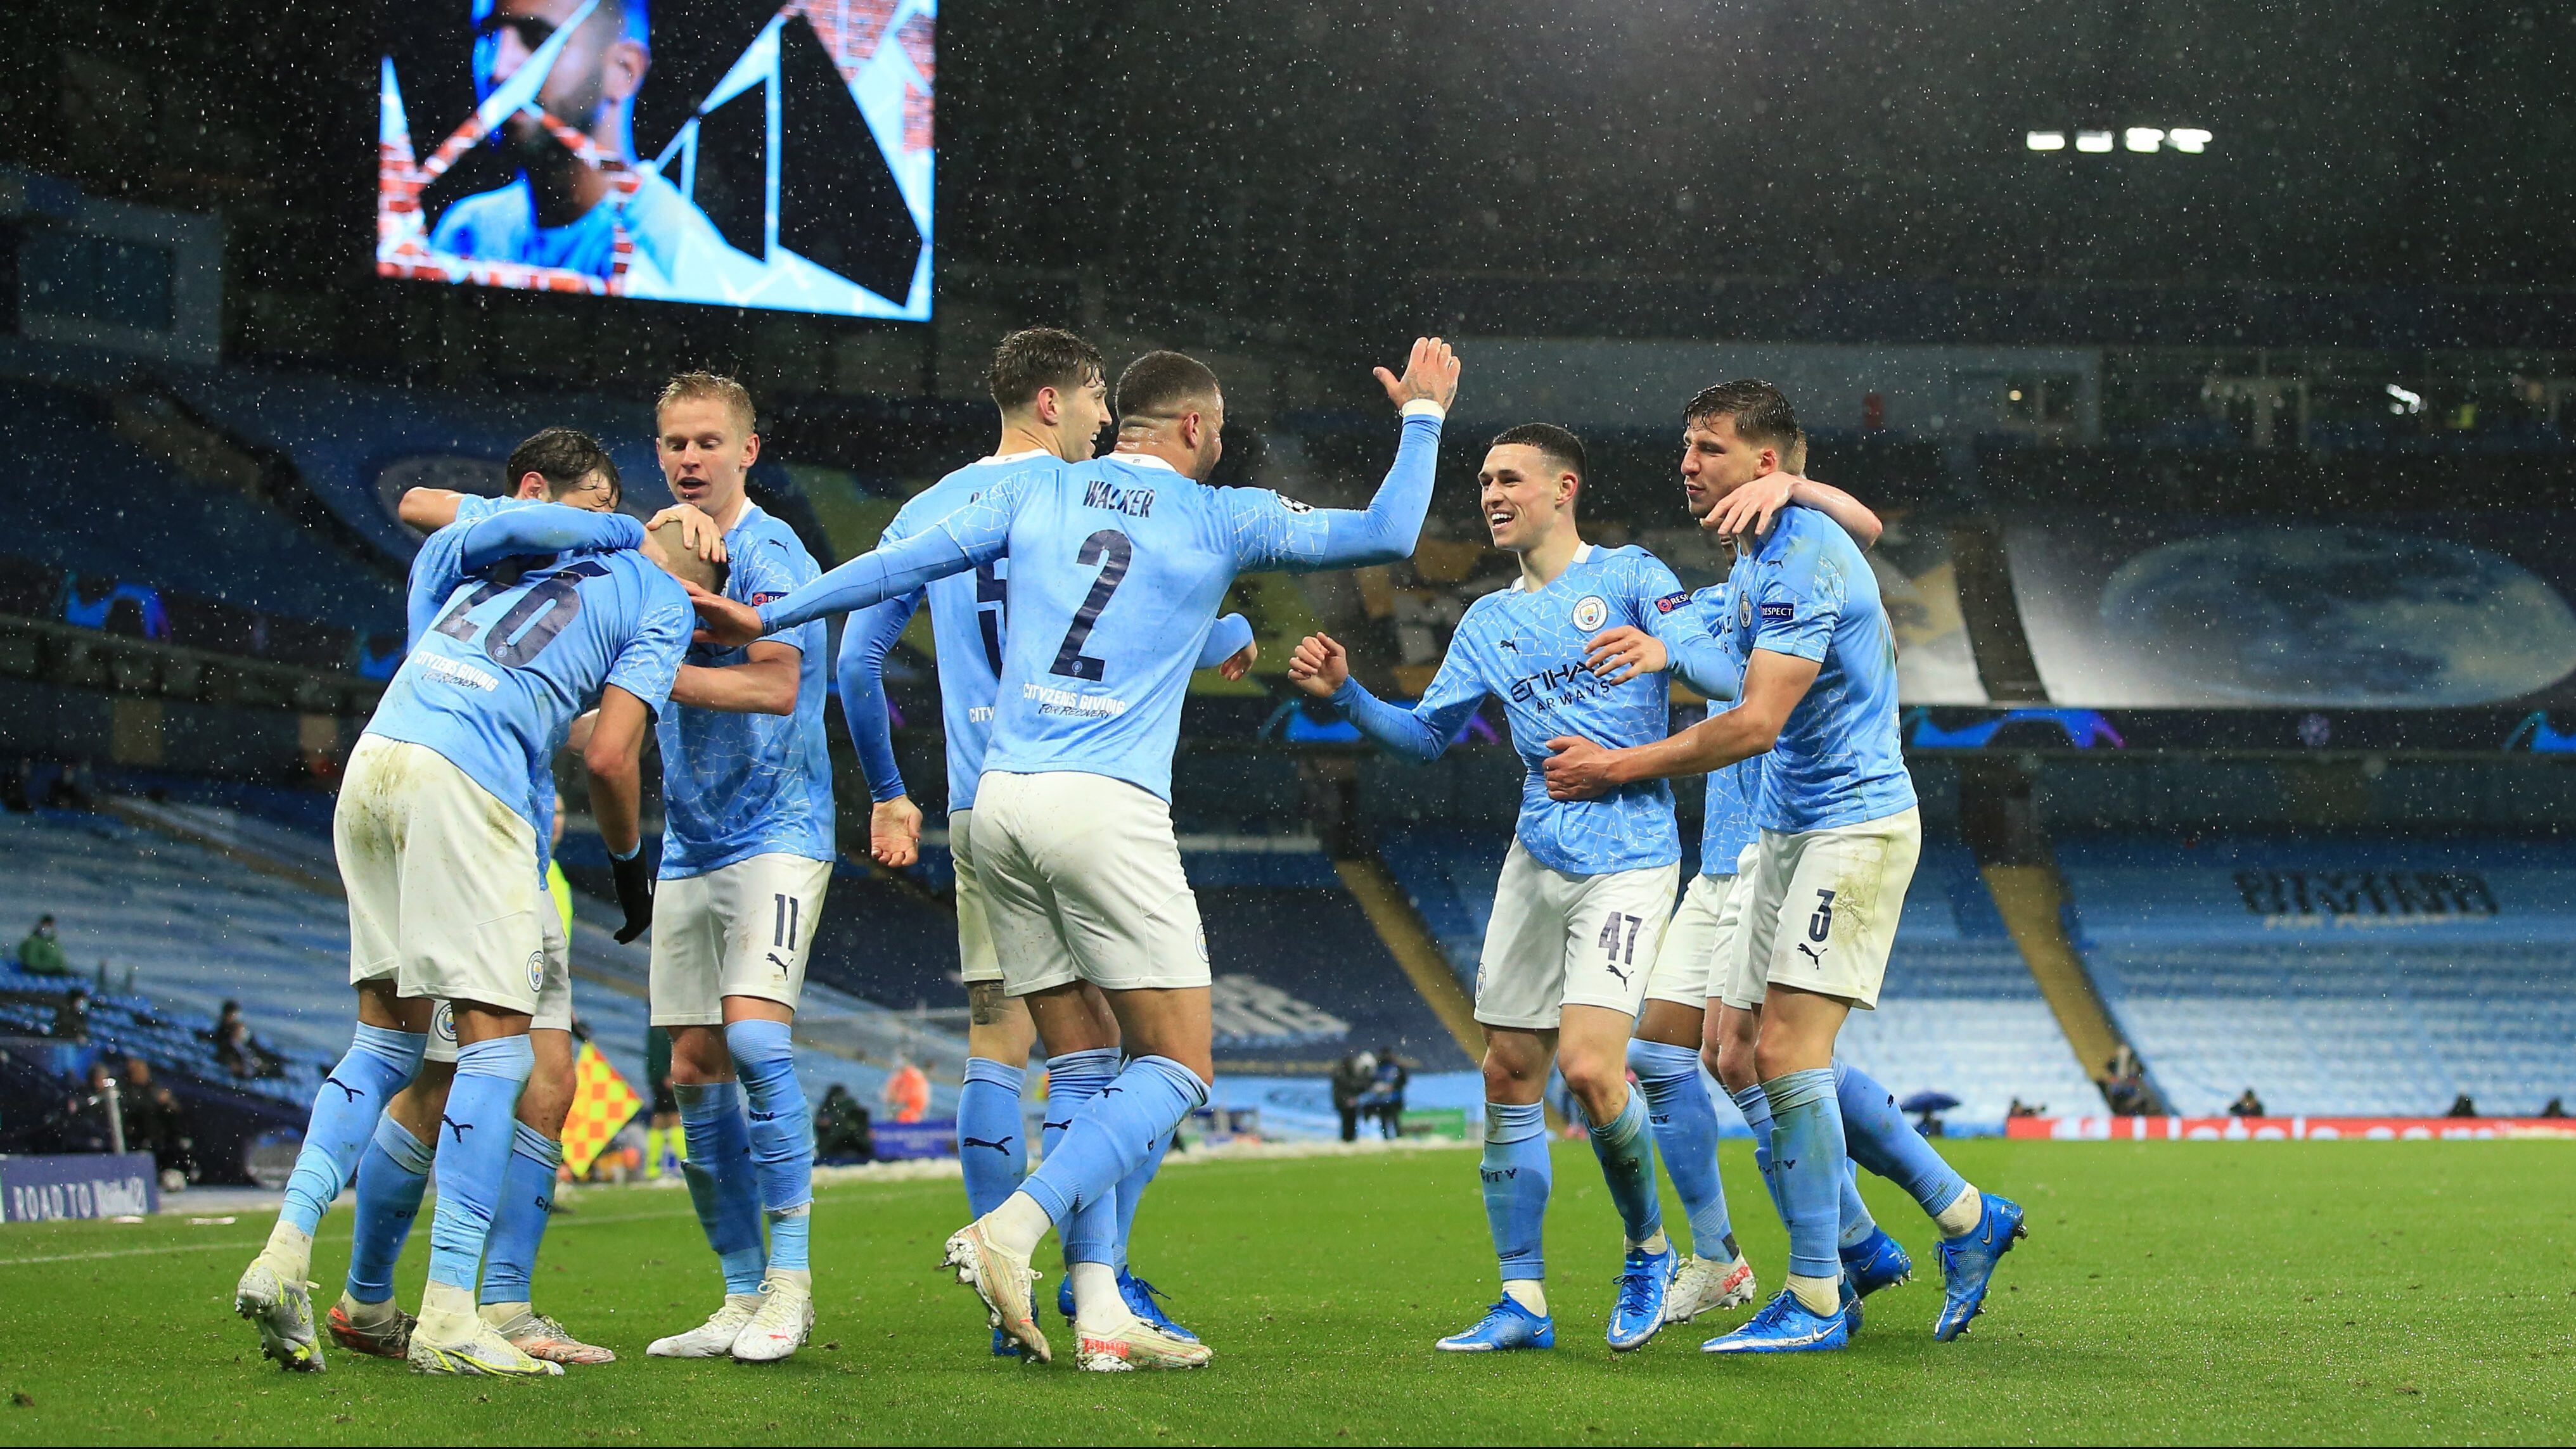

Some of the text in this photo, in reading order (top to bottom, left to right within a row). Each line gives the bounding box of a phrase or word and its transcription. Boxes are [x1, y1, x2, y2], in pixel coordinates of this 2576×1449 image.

[1082, 480, 1155, 518] WALKER
[1049, 529, 1132, 682] 2
[456, 663, 499, 692] GIVING
[1023, 683, 1126, 715] CITYZENS GIVING
[1510, 660, 1603, 703] ETIHA
[774, 893, 798, 951] 11
[1808, 889, 1836, 943] 3
[1598, 911, 1643, 966] 47
[13, 1184, 64, 1222] ROAD
[65, 1182, 92, 1220] TO
